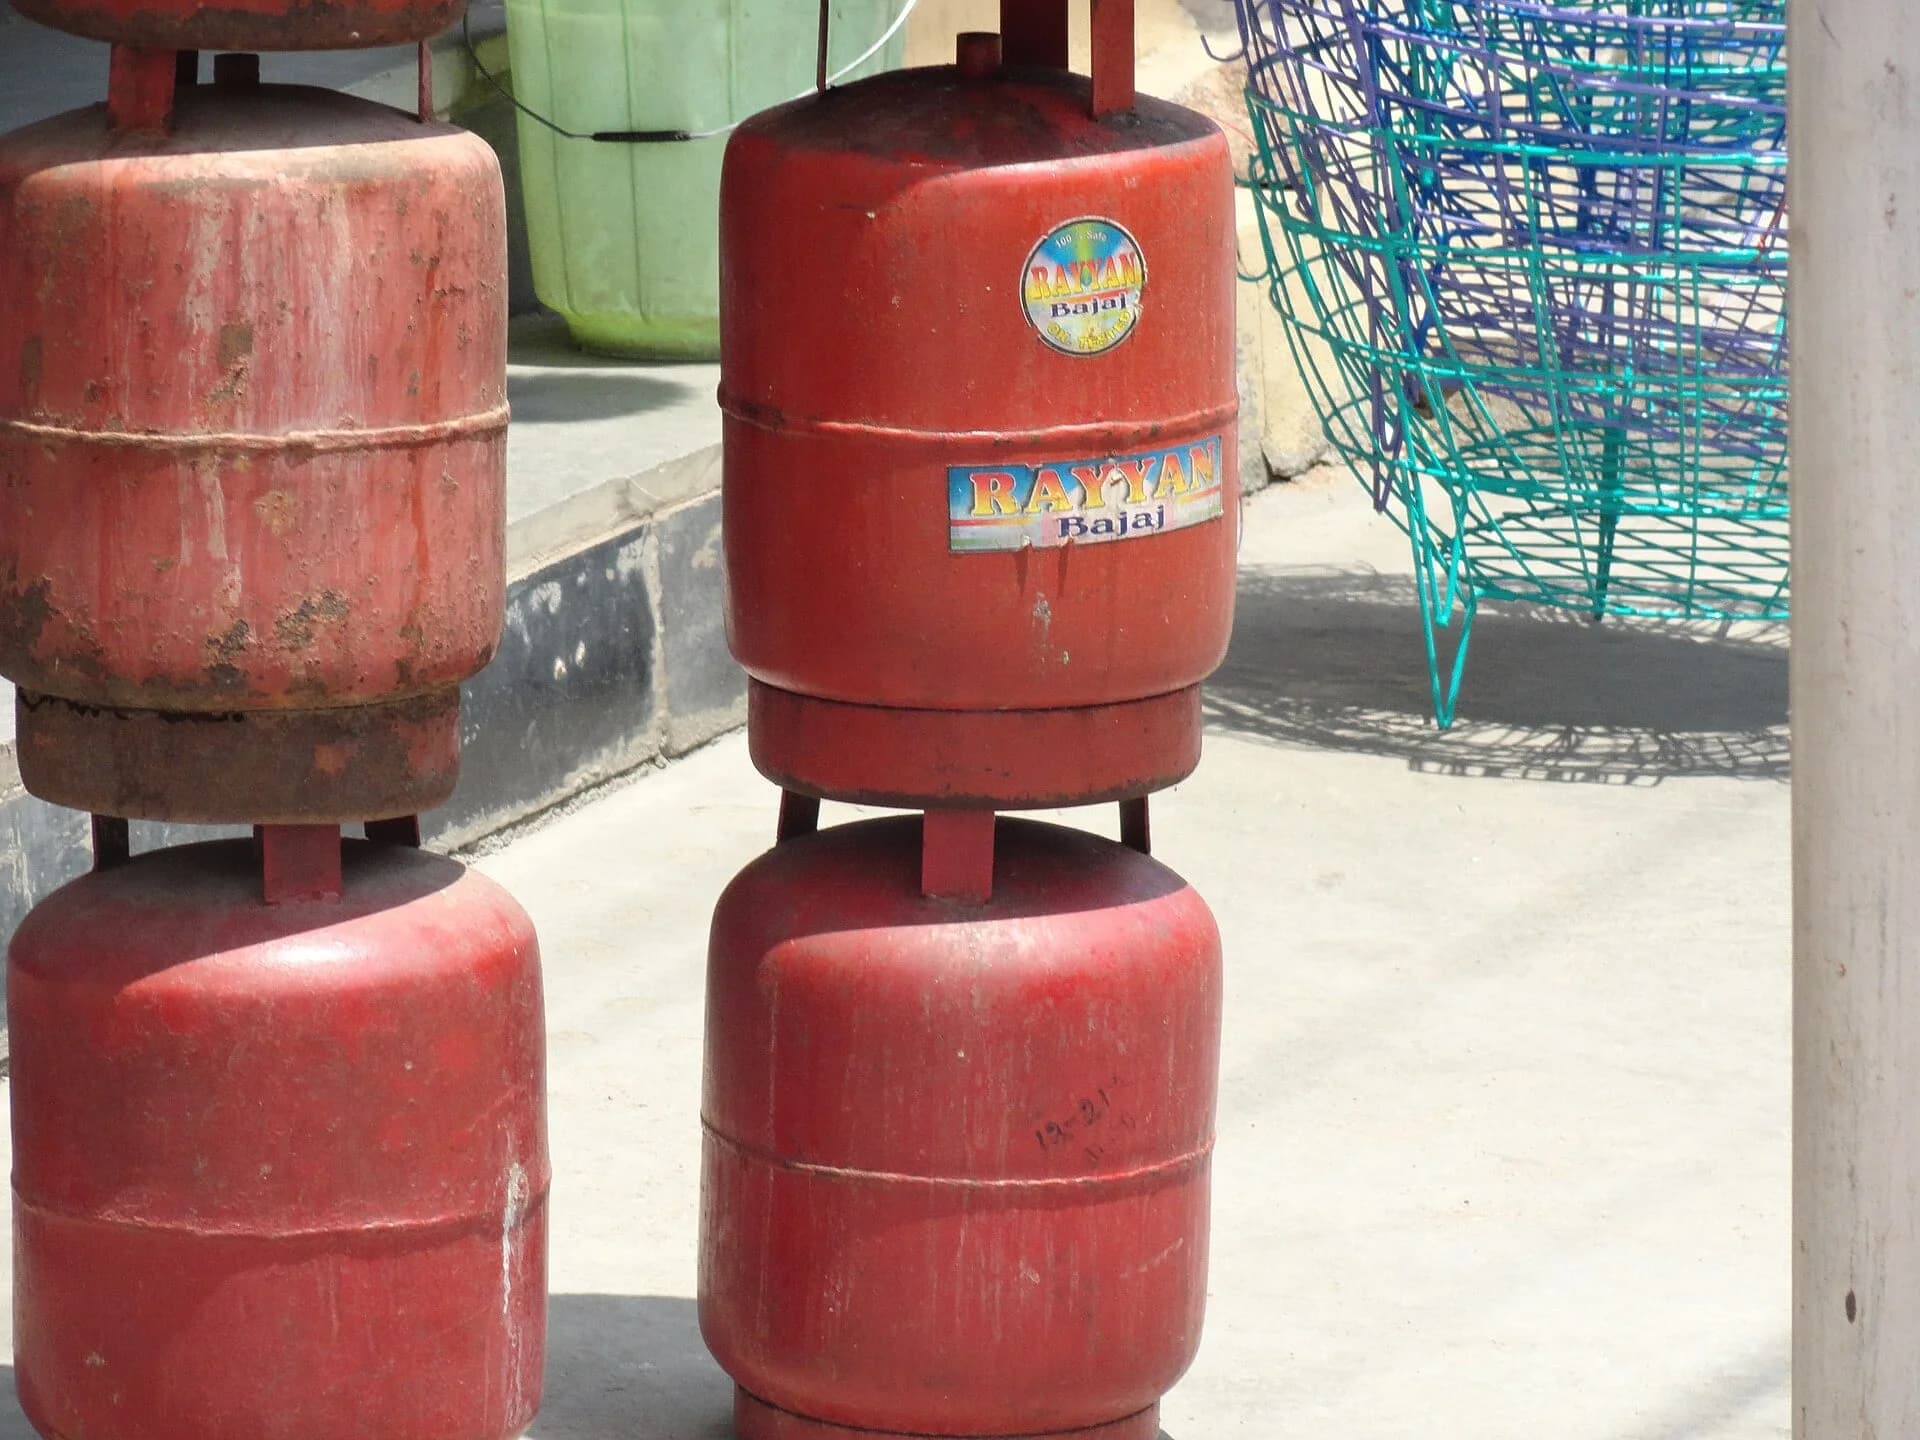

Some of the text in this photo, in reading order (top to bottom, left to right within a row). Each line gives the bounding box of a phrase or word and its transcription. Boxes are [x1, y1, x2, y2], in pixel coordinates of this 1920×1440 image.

[1027, 251, 1141, 300] RAYYAN
[1051, 293, 1128, 318] Bajaj
[969, 441, 1216, 517] RAYYAN
[1056, 504, 1166, 538] Bajaj
